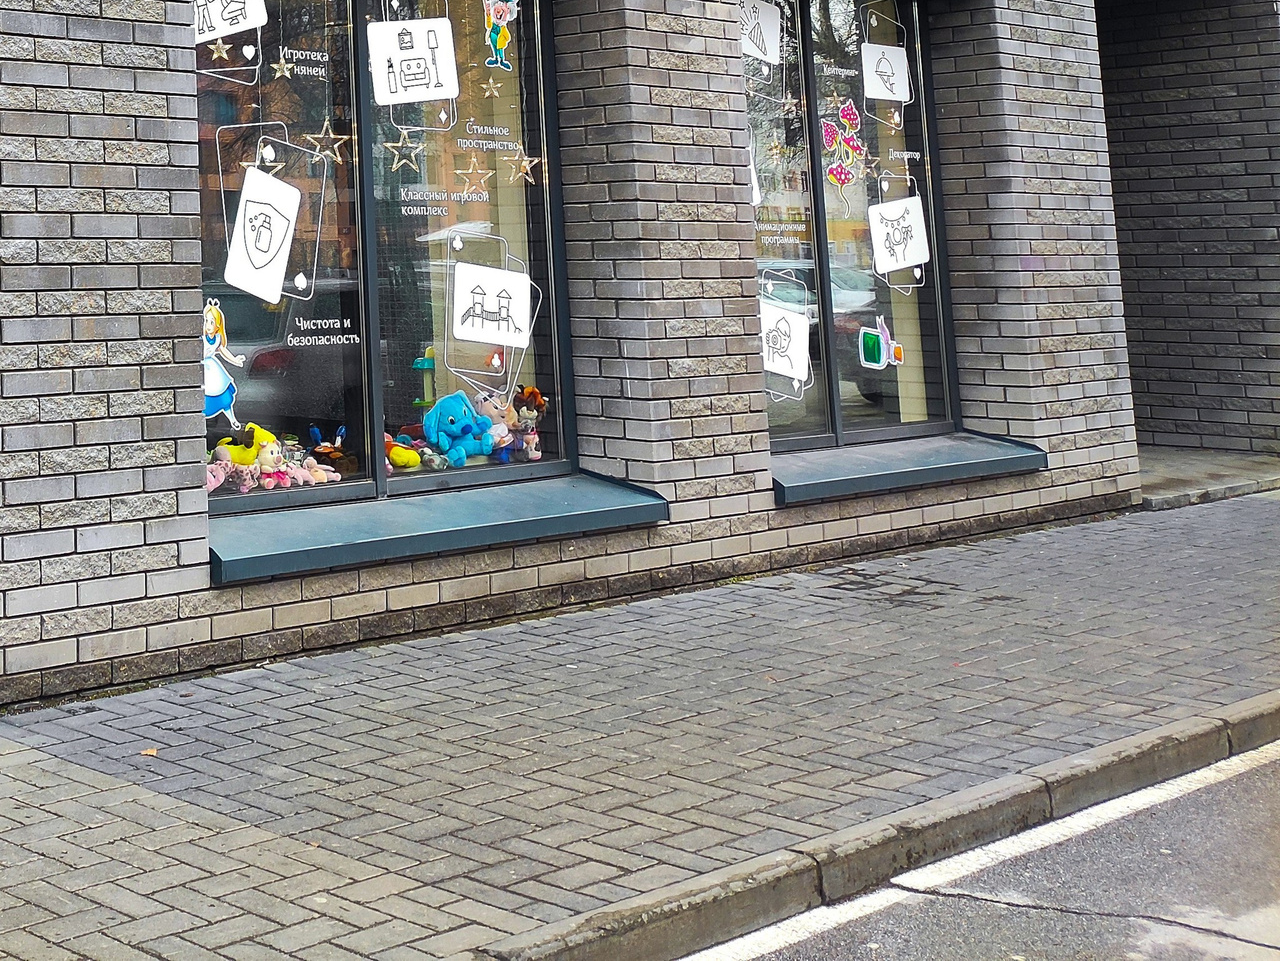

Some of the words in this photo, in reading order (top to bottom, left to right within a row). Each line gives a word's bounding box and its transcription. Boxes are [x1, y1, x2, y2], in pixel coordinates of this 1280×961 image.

[279, 46, 329, 62] Игротека
[293, 64, 326, 77] няней
[466, 122, 510, 135] Стильное
[457, 138, 519, 152] пространство
[400, 188, 448, 202] Классный
[450, 191, 490, 205] игровой
[401, 206, 449, 216] комплекс
[761, 236, 800, 246] программы
[295, 317, 341, 330] Чистота
[343, 318, 351, 328] и
[287, 333, 360, 346] безопасность
